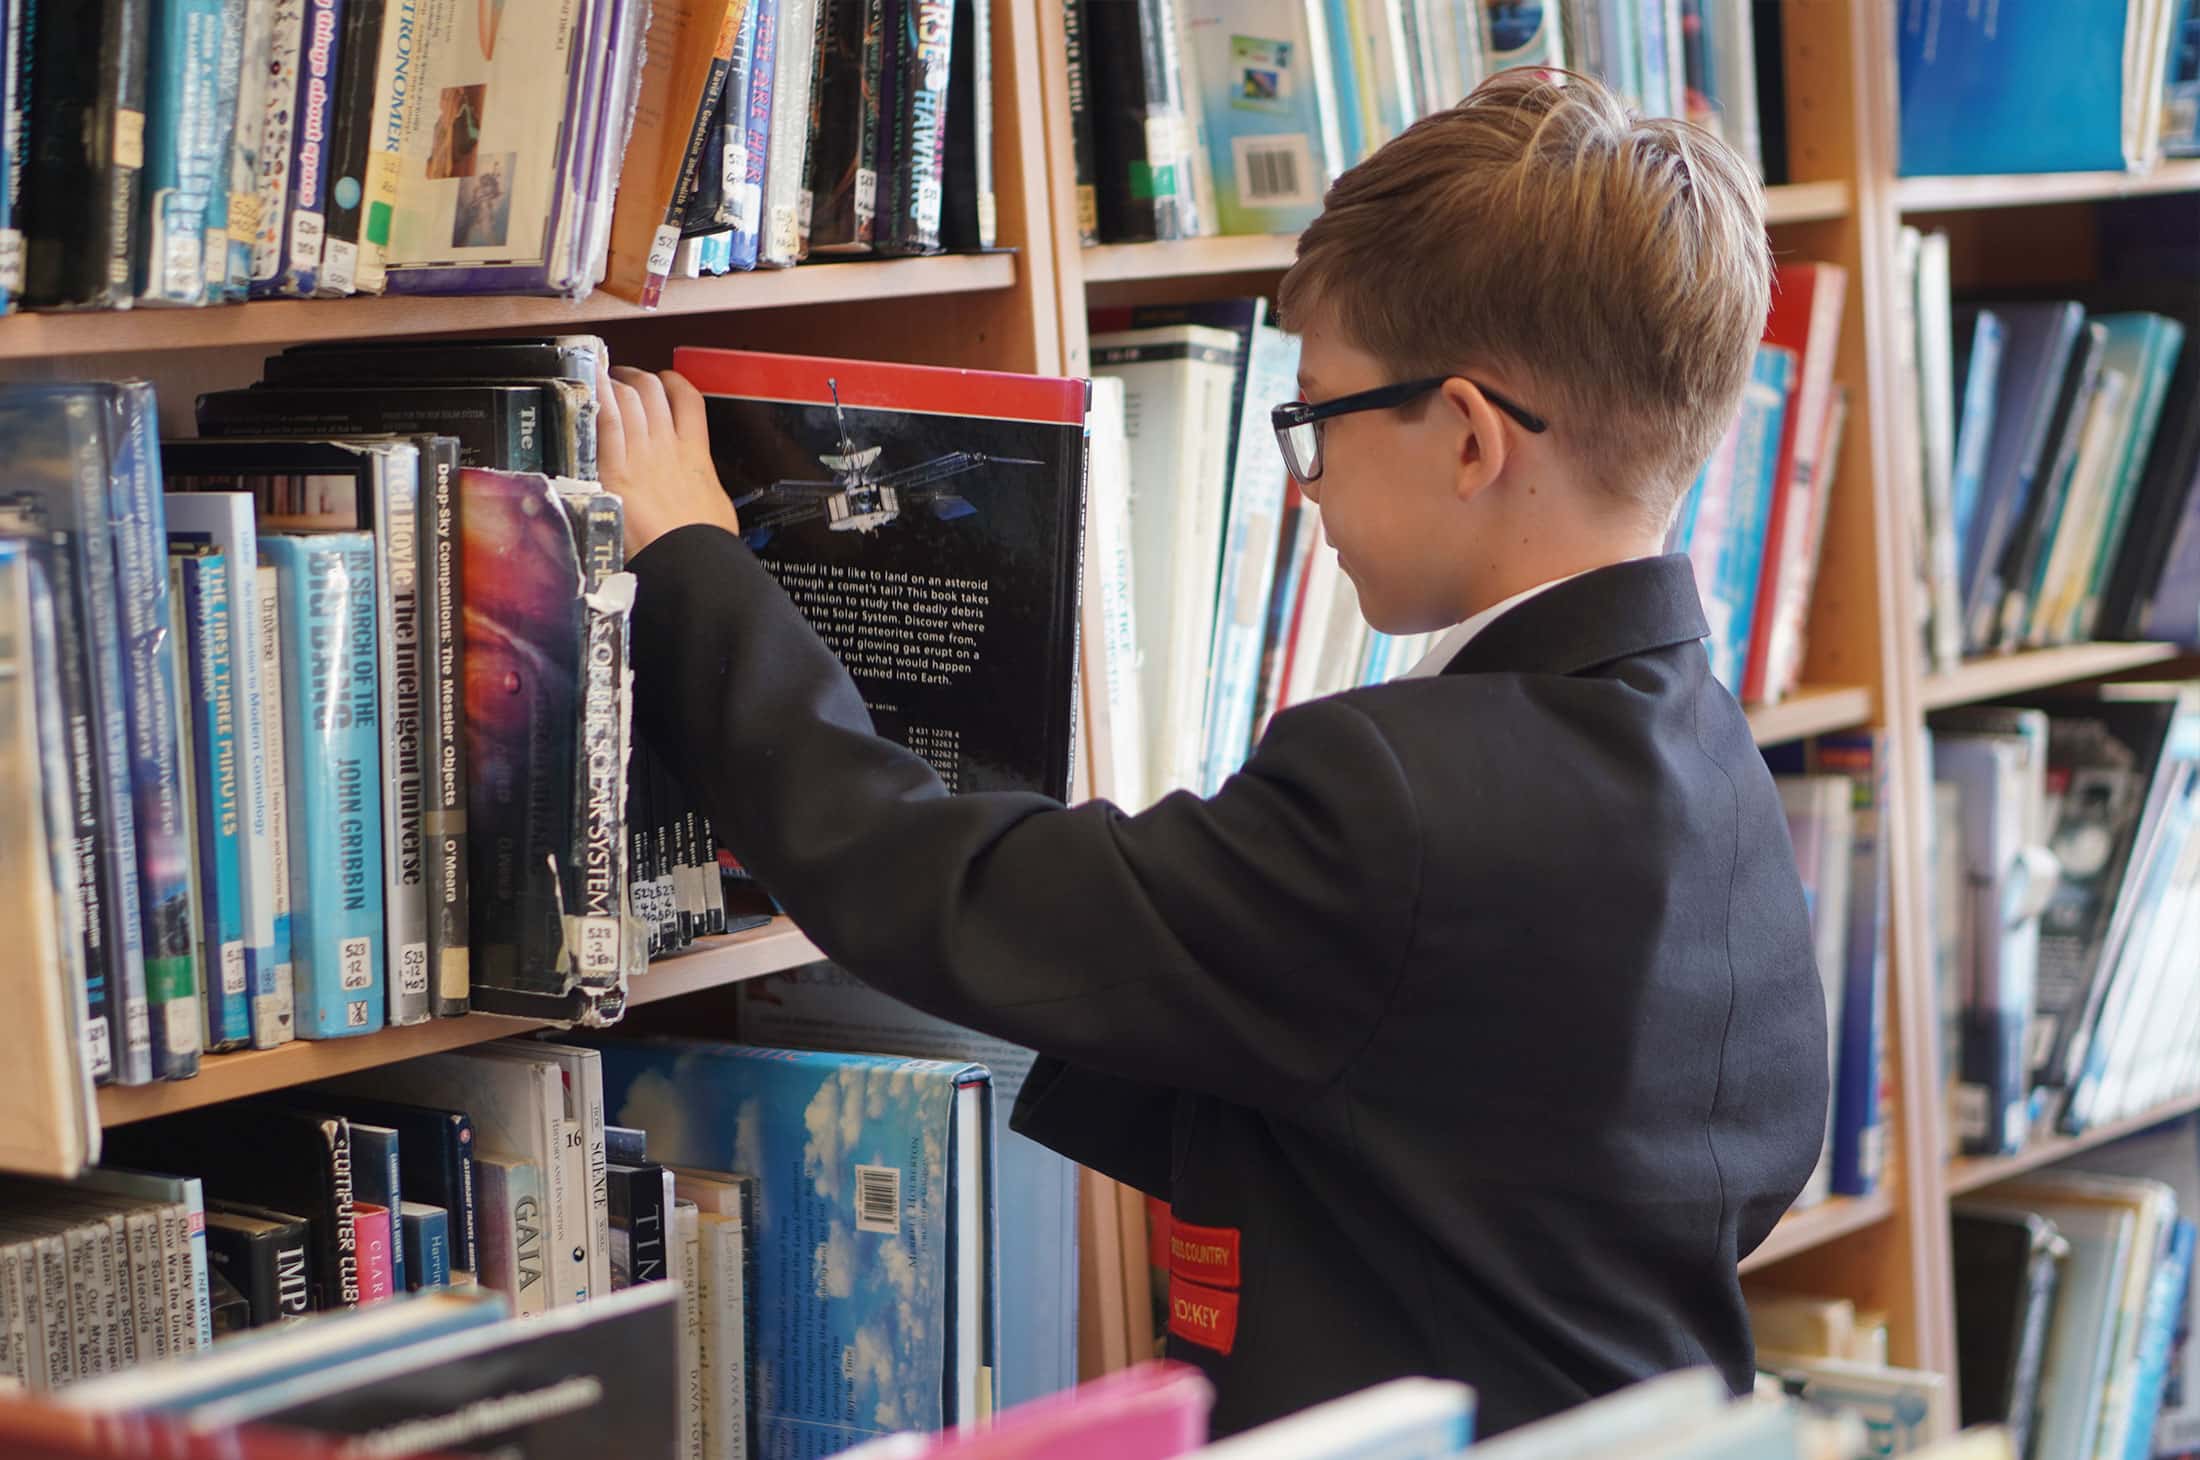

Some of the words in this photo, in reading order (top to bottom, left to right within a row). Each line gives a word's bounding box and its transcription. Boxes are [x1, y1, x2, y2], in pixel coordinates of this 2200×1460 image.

[309, 10, 335, 77] things
[385, 0, 416, 153] TRONOMER
[305, 78, 328, 141] about
[299, 142, 320, 208] space
[520, 405, 536, 450] The
[435, 463, 452, 537] Deep-Sky
[209, 565, 227, 604] THE
[438, 541, 453, 643] Companions:
[783, 562, 816, 575] would
[820, 563, 827, 575] it
[831, 564, 844, 577] be
[848, 566, 866, 579] like
[870, 570, 881, 582] to
[885, 569, 908, 583] land
[911, 575, 925, 585] on
[928, 577, 941, 587] an
[944, 577, 988, 591] asteroid
[783, 575, 824, 591] through
[828, 581, 834, 590] a
[837, 579, 877, 595] comet's
[880, 585, 904, 597] tail?
[906, 586, 928, 600] This
[931, 589, 958, 603] book
[961, 591, 989, 606] takes
[351, 577, 373, 657] SEARCH
[394, 590, 417, 639] The
[794, 591, 800, 601] a
[803, 592, 842, 605] mission
[845, 595, 857, 606] to
[860, 597, 889, 612] study
[892, 599, 910, 612] the
[912, 601, 948, 617] deadly
[951, 605, 984, 619] debris
[812, 607, 829, 619] the
[832, 607, 858, 620] Solar
[861, 610, 901, 625] System.
[904, 614, 949, 629] Discover
[951, 619, 985, 633] where
[212, 610, 229, 668] FIRST
[262, 596, 277, 661] Universe
[834, 622, 855, 634] and
[857, 624, 914, 639] meteorites
[917, 630, 945, 643] come
[949, 632, 977, 648] from,
[842, 635, 854, 647] of
[857, 638, 900, 654] glowing
[903, 644, 921, 656] gas
[923, 646, 953, 659] erupt
[956, 649, 970, 659] on
[973, 652, 980, 660] a
[353, 661, 374, 683] OF
[442, 645, 453, 675] The
[844, 651, 863, 662] out
[865, 653, 893, 665] what
[895, 655, 929, 669] would
[932, 658, 972, 673] happen
[852, 664, 893, 679] crashed
[896, 669, 918, 681] into
[920, 672, 953, 686] Earth.
[216, 672, 233, 736] THREE
[249, 691, 263, 751] Modern
[355, 688, 375, 729] THE
[395, 642, 420, 775] Intelligent
[442, 679, 456, 741] Messier
[915, 726, 928, 736] 431
[915, 737, 928, 747] 431
[219, 739, 238, 837] MINUTES
[253, 754, 265, 837] Cosmology
[336, 758, 362, 813] JOHN
[441, 746, 457, 807] Objects
[589, 738, 610, 820] SOLAR
[401, 779, 422, 886] Universe
[339, 819, 366, 911] GRIBBIN
[444, 840, 457, 903] O'Meara
[587, 825, 610, 917] SYSTEM
[565, 1129, 583, 1148] 16
[463, 1157, 473, 1208] ASTRONAUT
[590, 1141, 607, 1210] SCIENCE
[333, 1148, 356, 1251] COMPUTER
[116, 1229, 126, 1255] The
[133, 1227, 145, 1254] The
[148, 1223, 159, 1250] Our
[164, 1217, 176, 1250] How
[178, 1217, 190, 1245] Our
[466, 1210, 475, 1240] TRAVEL
[514, 1195, 542, 1293] GAIA
[23, 1256, 35, 1284] The
[72, 1246, 83, 1273] The
[100, 1235, 112, 1288] Saturn:
[151, 1258, 162, 1298] Solar
[167, 1252, 178, 1285] Was
[181, 1252, 194, 1292] Milky
[342, 1255, 359, 1302] CLUB
[468, 1242, 477, 1273] GUIDES
[725, 1229, 741, 1311] Longitude
[42, 1252, 56, 1314] Mercury:
[88, 1288, 99, 1316] Our
[117, 1259, 131, 1304] Space
[136, 1262, 151, 1335] Asteroids
[169, 1288, 180, 1311] the
[683, 1238, 699, 1338] Longitude
[26, 1293, 37, 1324] Sun
[55, 1298, 68, 1325] Our
[74, 1281, 87, 1335] Earth's
[105, 1291, 115, 1319] The
[185, 1297, 196, 1329] Way
[48, 1321, 59, 1348] The
[59, 1330, 70, 1373] Home
[172, 1313, 183, 1353] Unive
[689, 1368, 700, 1413] DAVA
[729, 1362, 741, 1408] DAVA
